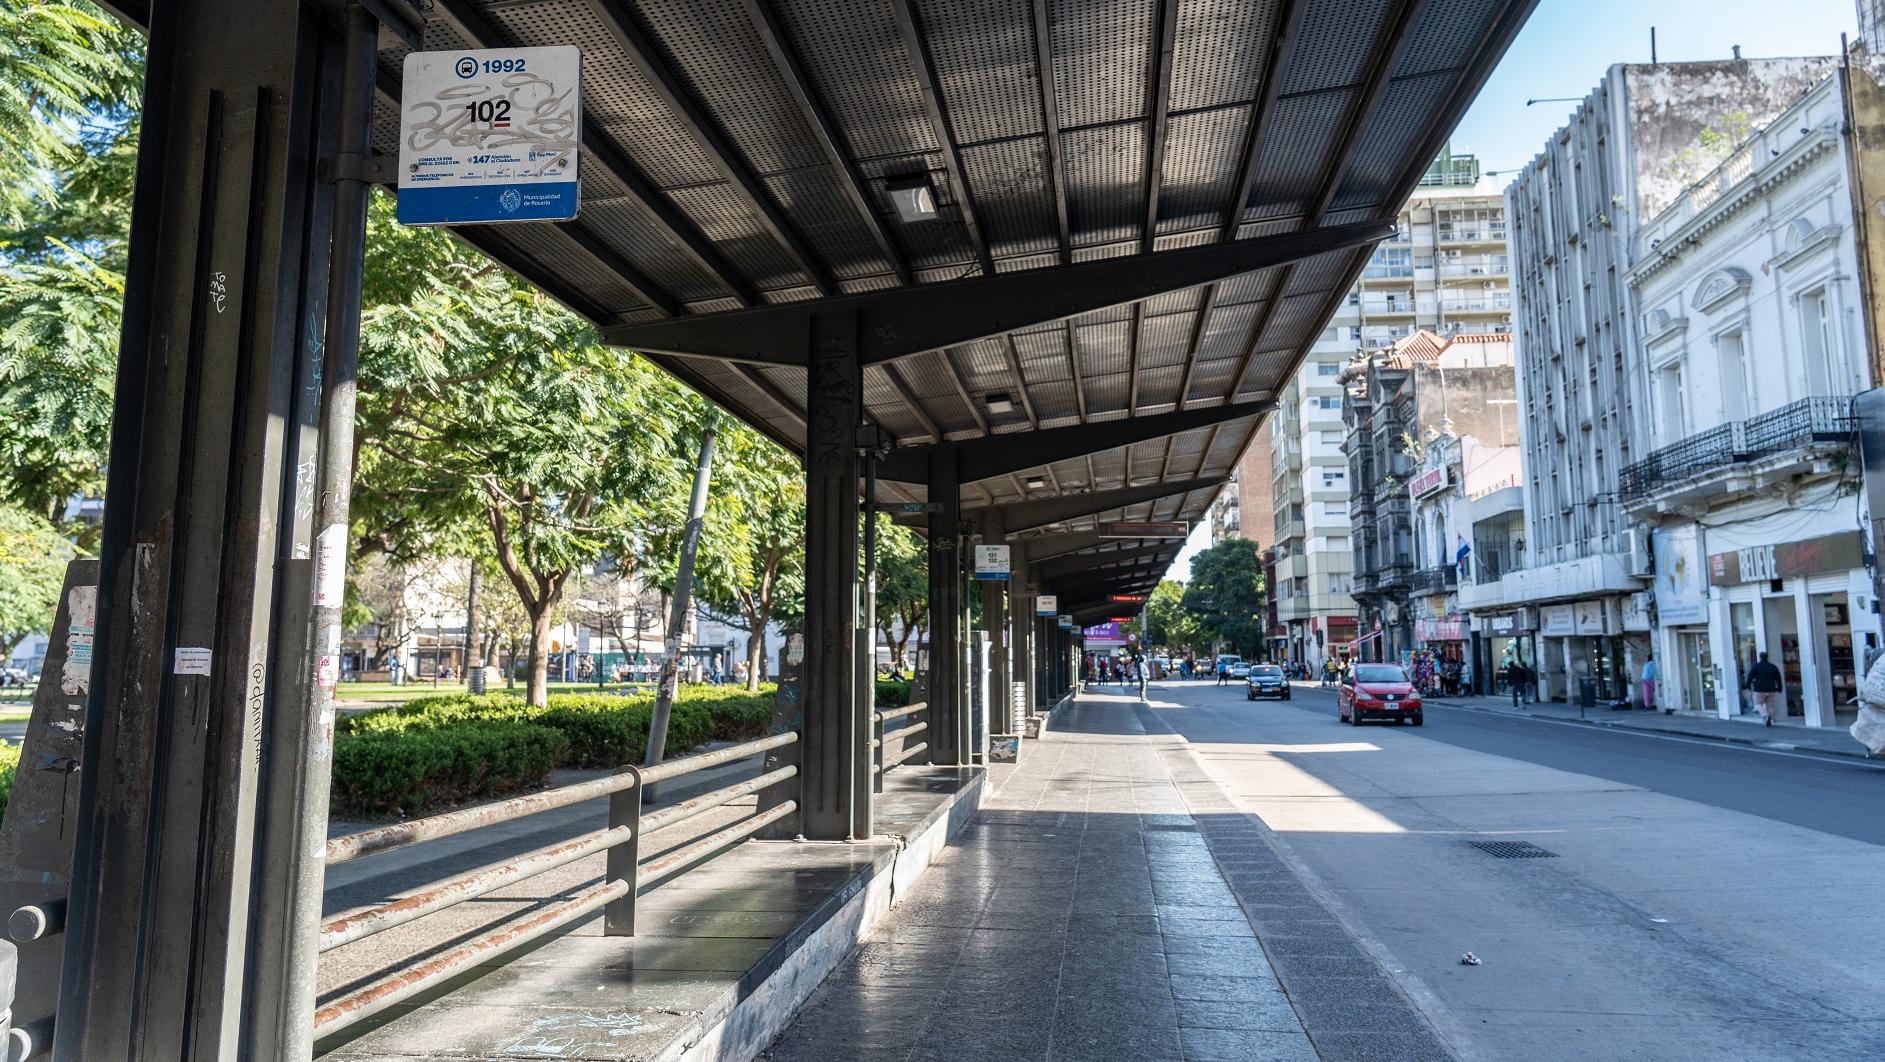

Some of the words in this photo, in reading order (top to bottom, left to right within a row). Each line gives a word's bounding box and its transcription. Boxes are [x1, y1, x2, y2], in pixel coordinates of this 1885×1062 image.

[482, 58, 526, 73] 1992
[465, 99, 511, 123] 102
[473, 155, 490, 164] 147
[523, 193, 561, 201] Municipalidad
[1738, 545, 1778, 582] BELIEVE
